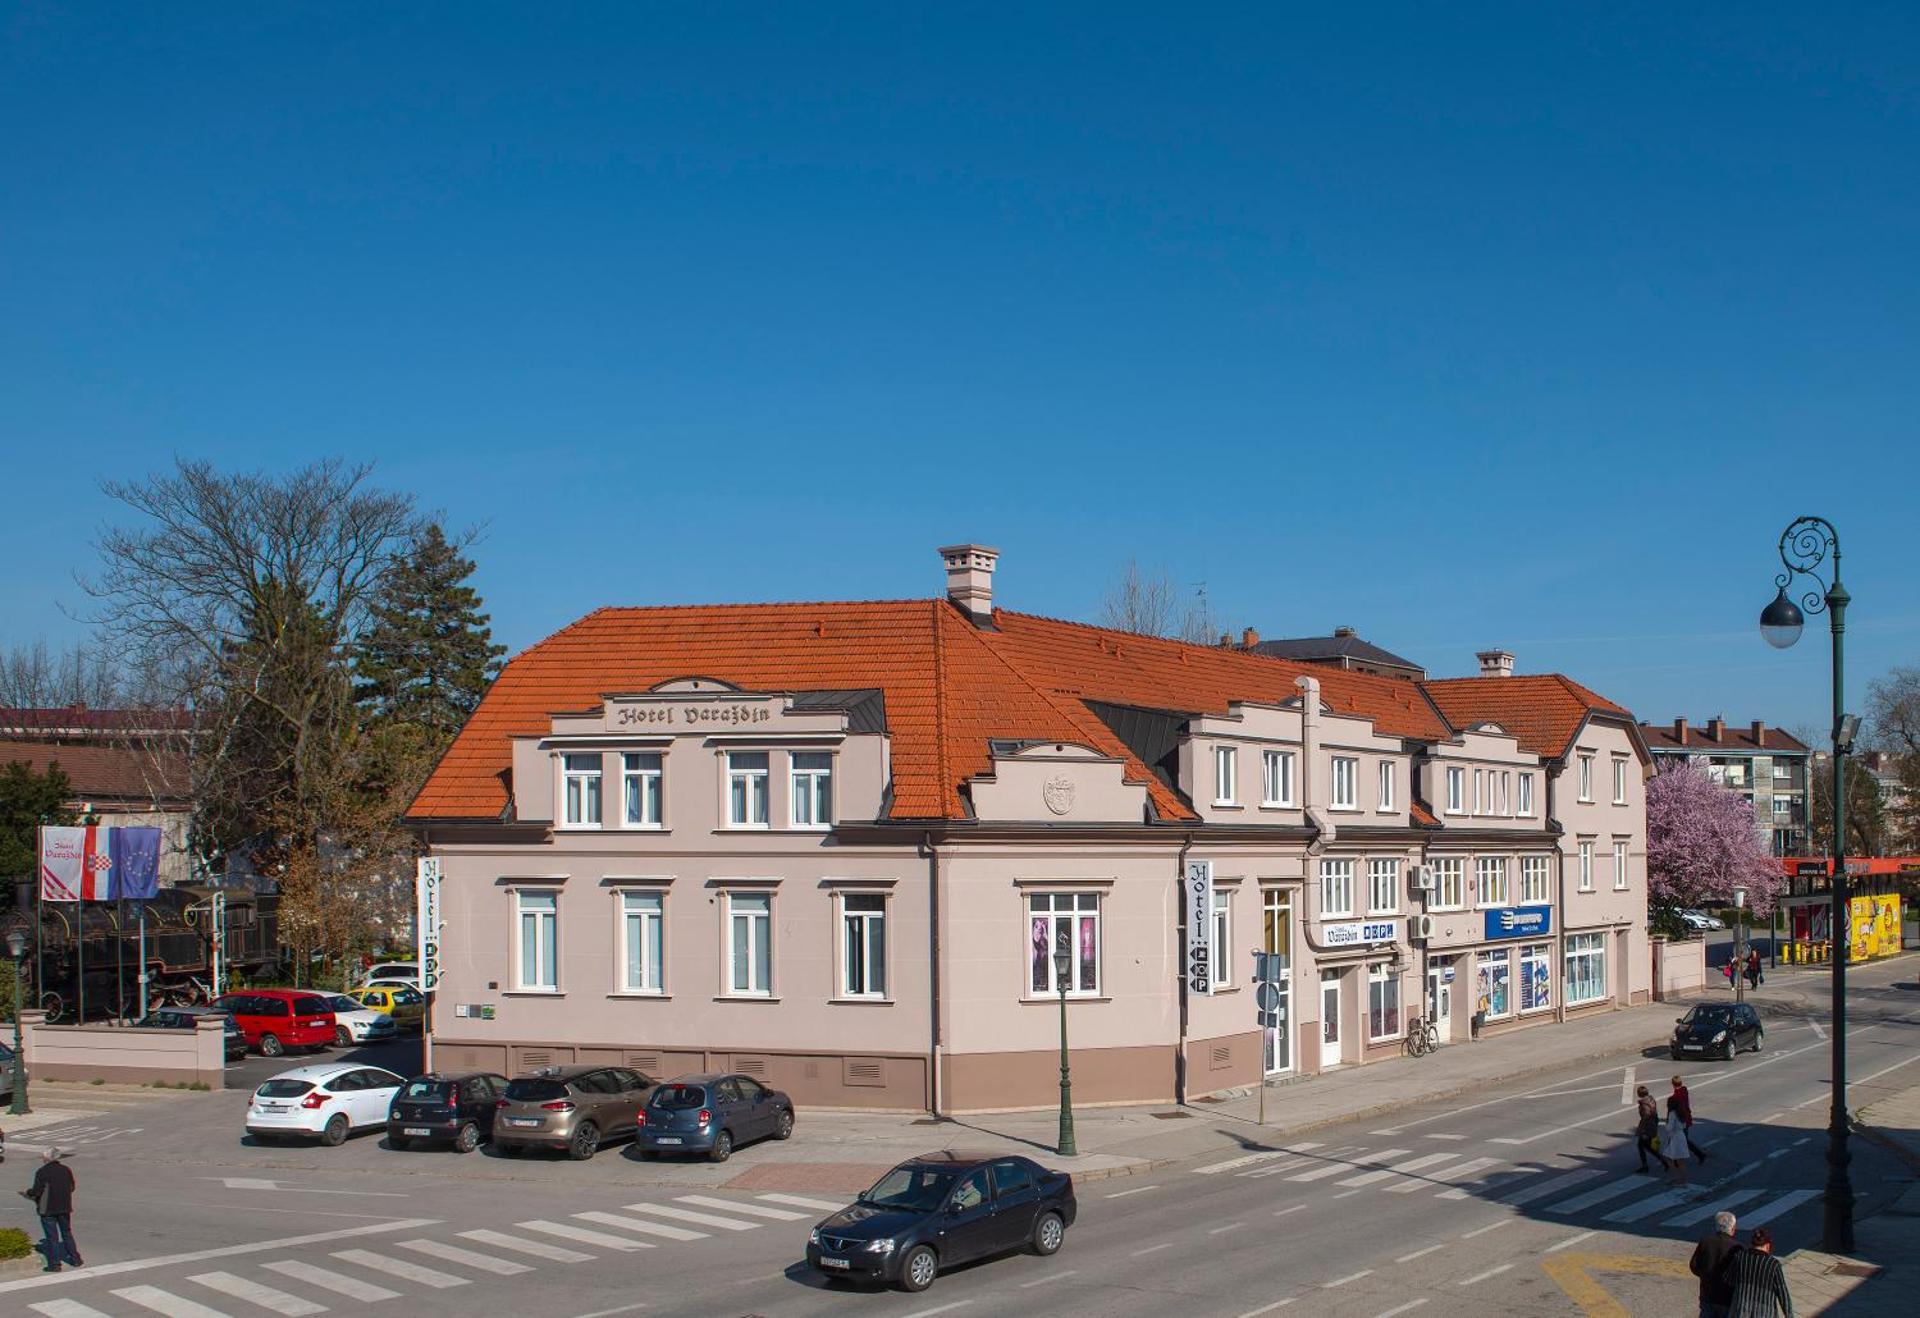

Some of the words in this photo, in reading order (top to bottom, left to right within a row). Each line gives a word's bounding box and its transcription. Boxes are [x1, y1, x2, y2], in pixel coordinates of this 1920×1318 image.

[618, 706, 674, 725] Hotel
[684, 704, 771, 725] Varaždin
[425, 860, 436, 933] Hotel
[1190, 864, 1206, 938] Hotel
